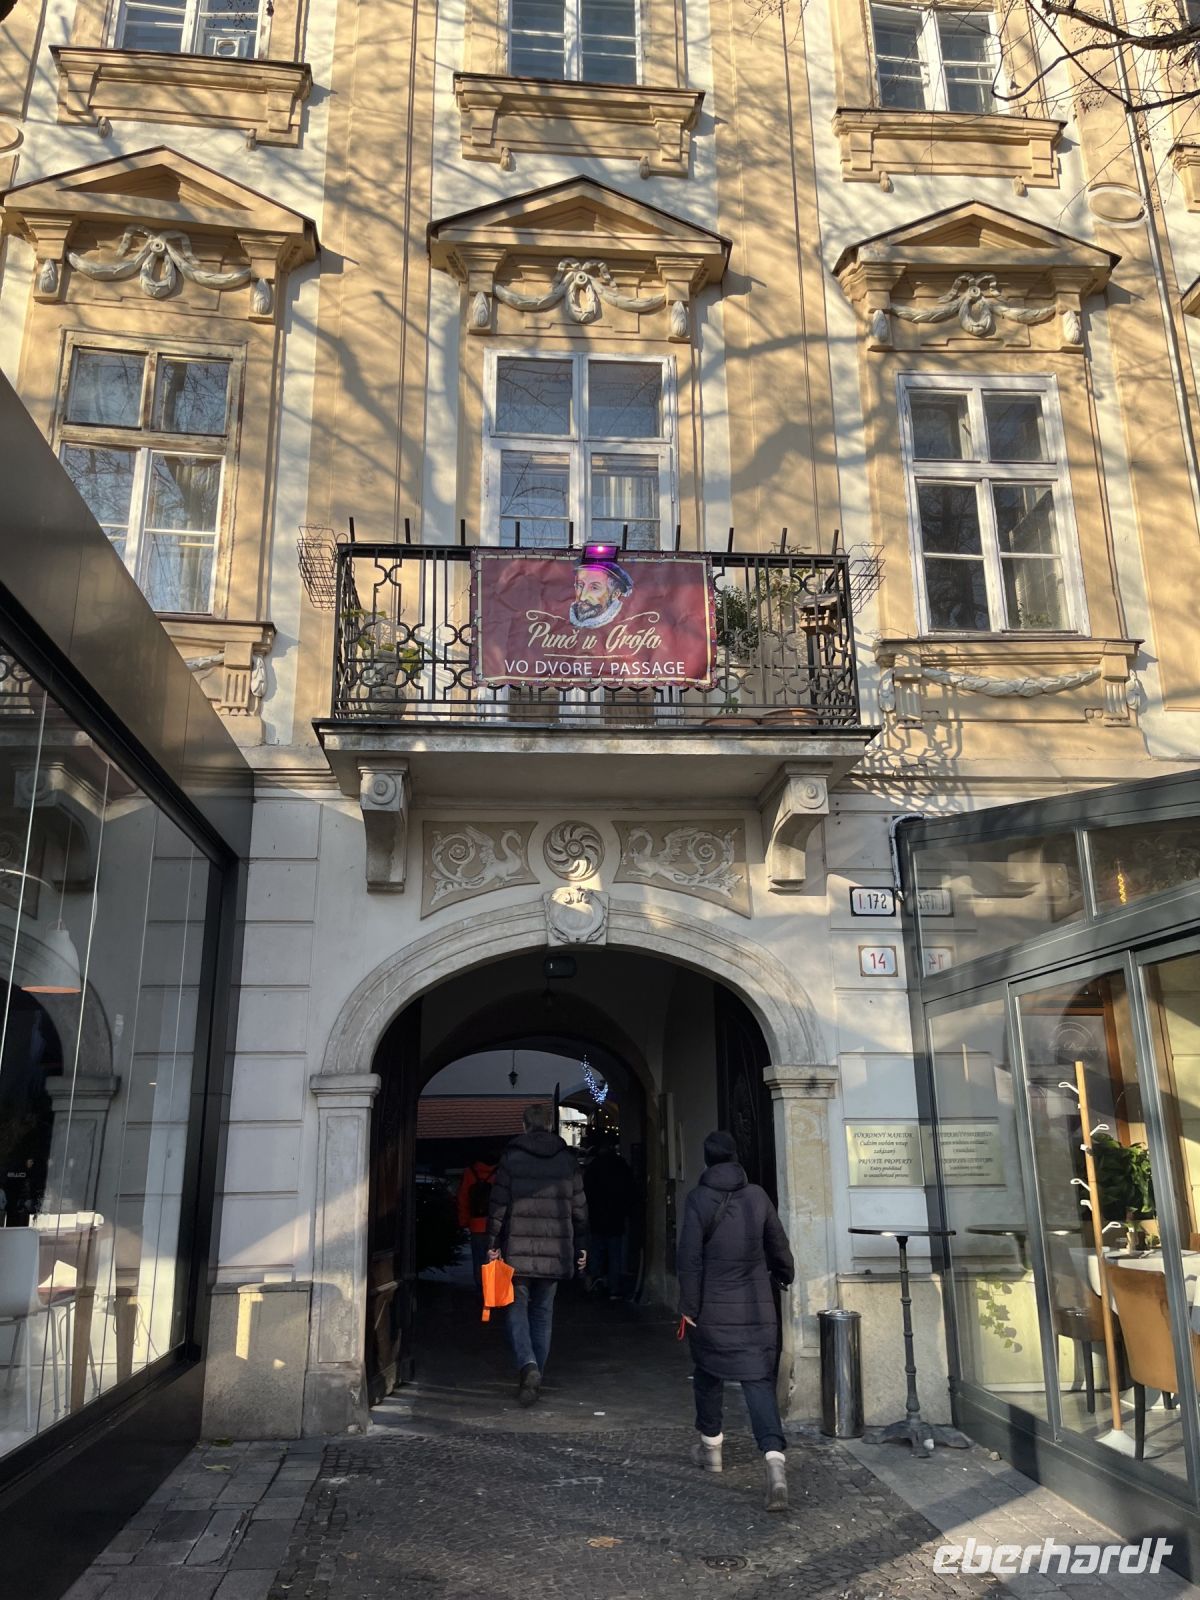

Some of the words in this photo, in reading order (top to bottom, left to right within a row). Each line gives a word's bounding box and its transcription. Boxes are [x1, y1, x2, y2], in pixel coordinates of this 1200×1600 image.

[528, 621, 578, 649] Punč
[582, 635, 598, 650] u
[605, 624, 662, 655] Grófa
[504, 659, 529, 674] VO
[535, 660, 593, 675] DVORE
[597, 661, 605, 676] /
[610, 661, 686, 675] PASSAGE
[869, 952, 887, 970] 14
